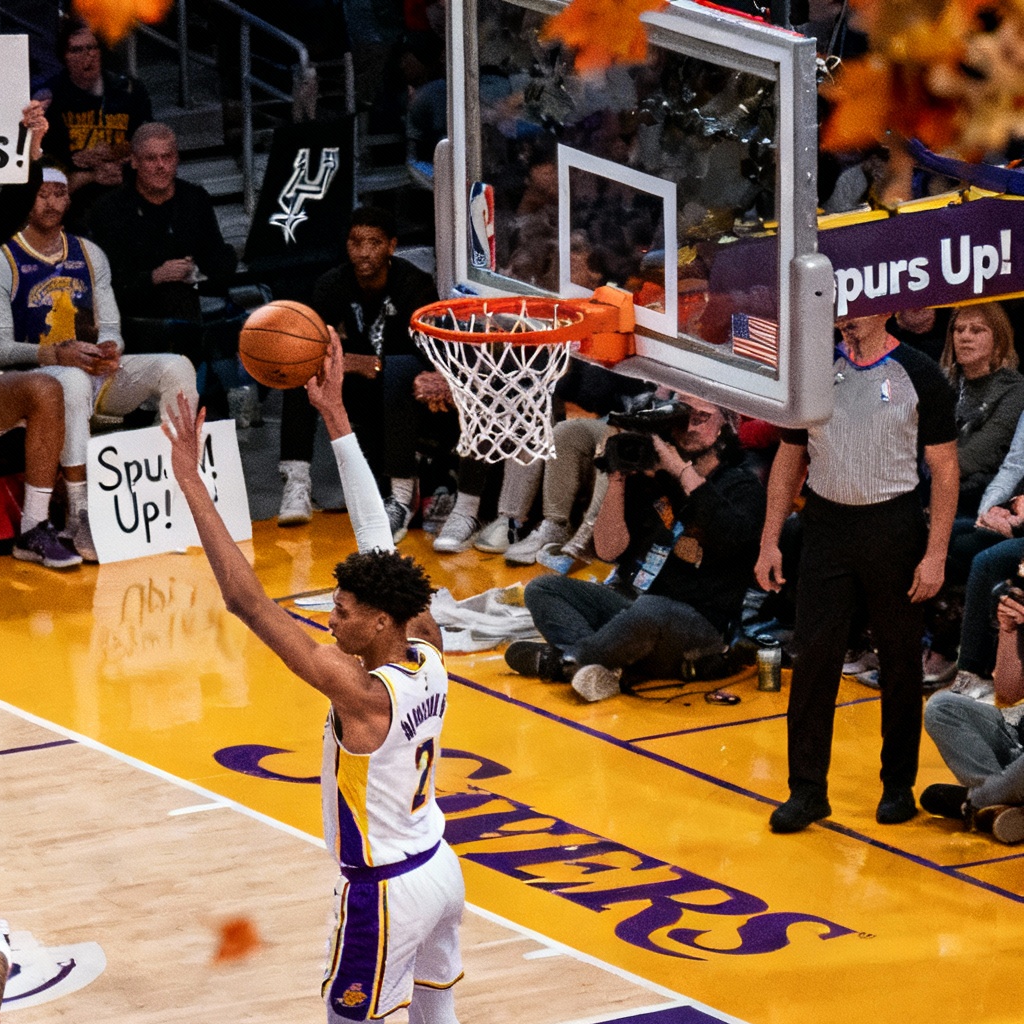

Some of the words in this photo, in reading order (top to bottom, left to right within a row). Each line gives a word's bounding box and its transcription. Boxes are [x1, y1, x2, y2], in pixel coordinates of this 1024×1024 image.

[833, 257, 930, 317] purs
[940, 229, 1012, 294] Up!
[114, 489, 173, 543] Up!
